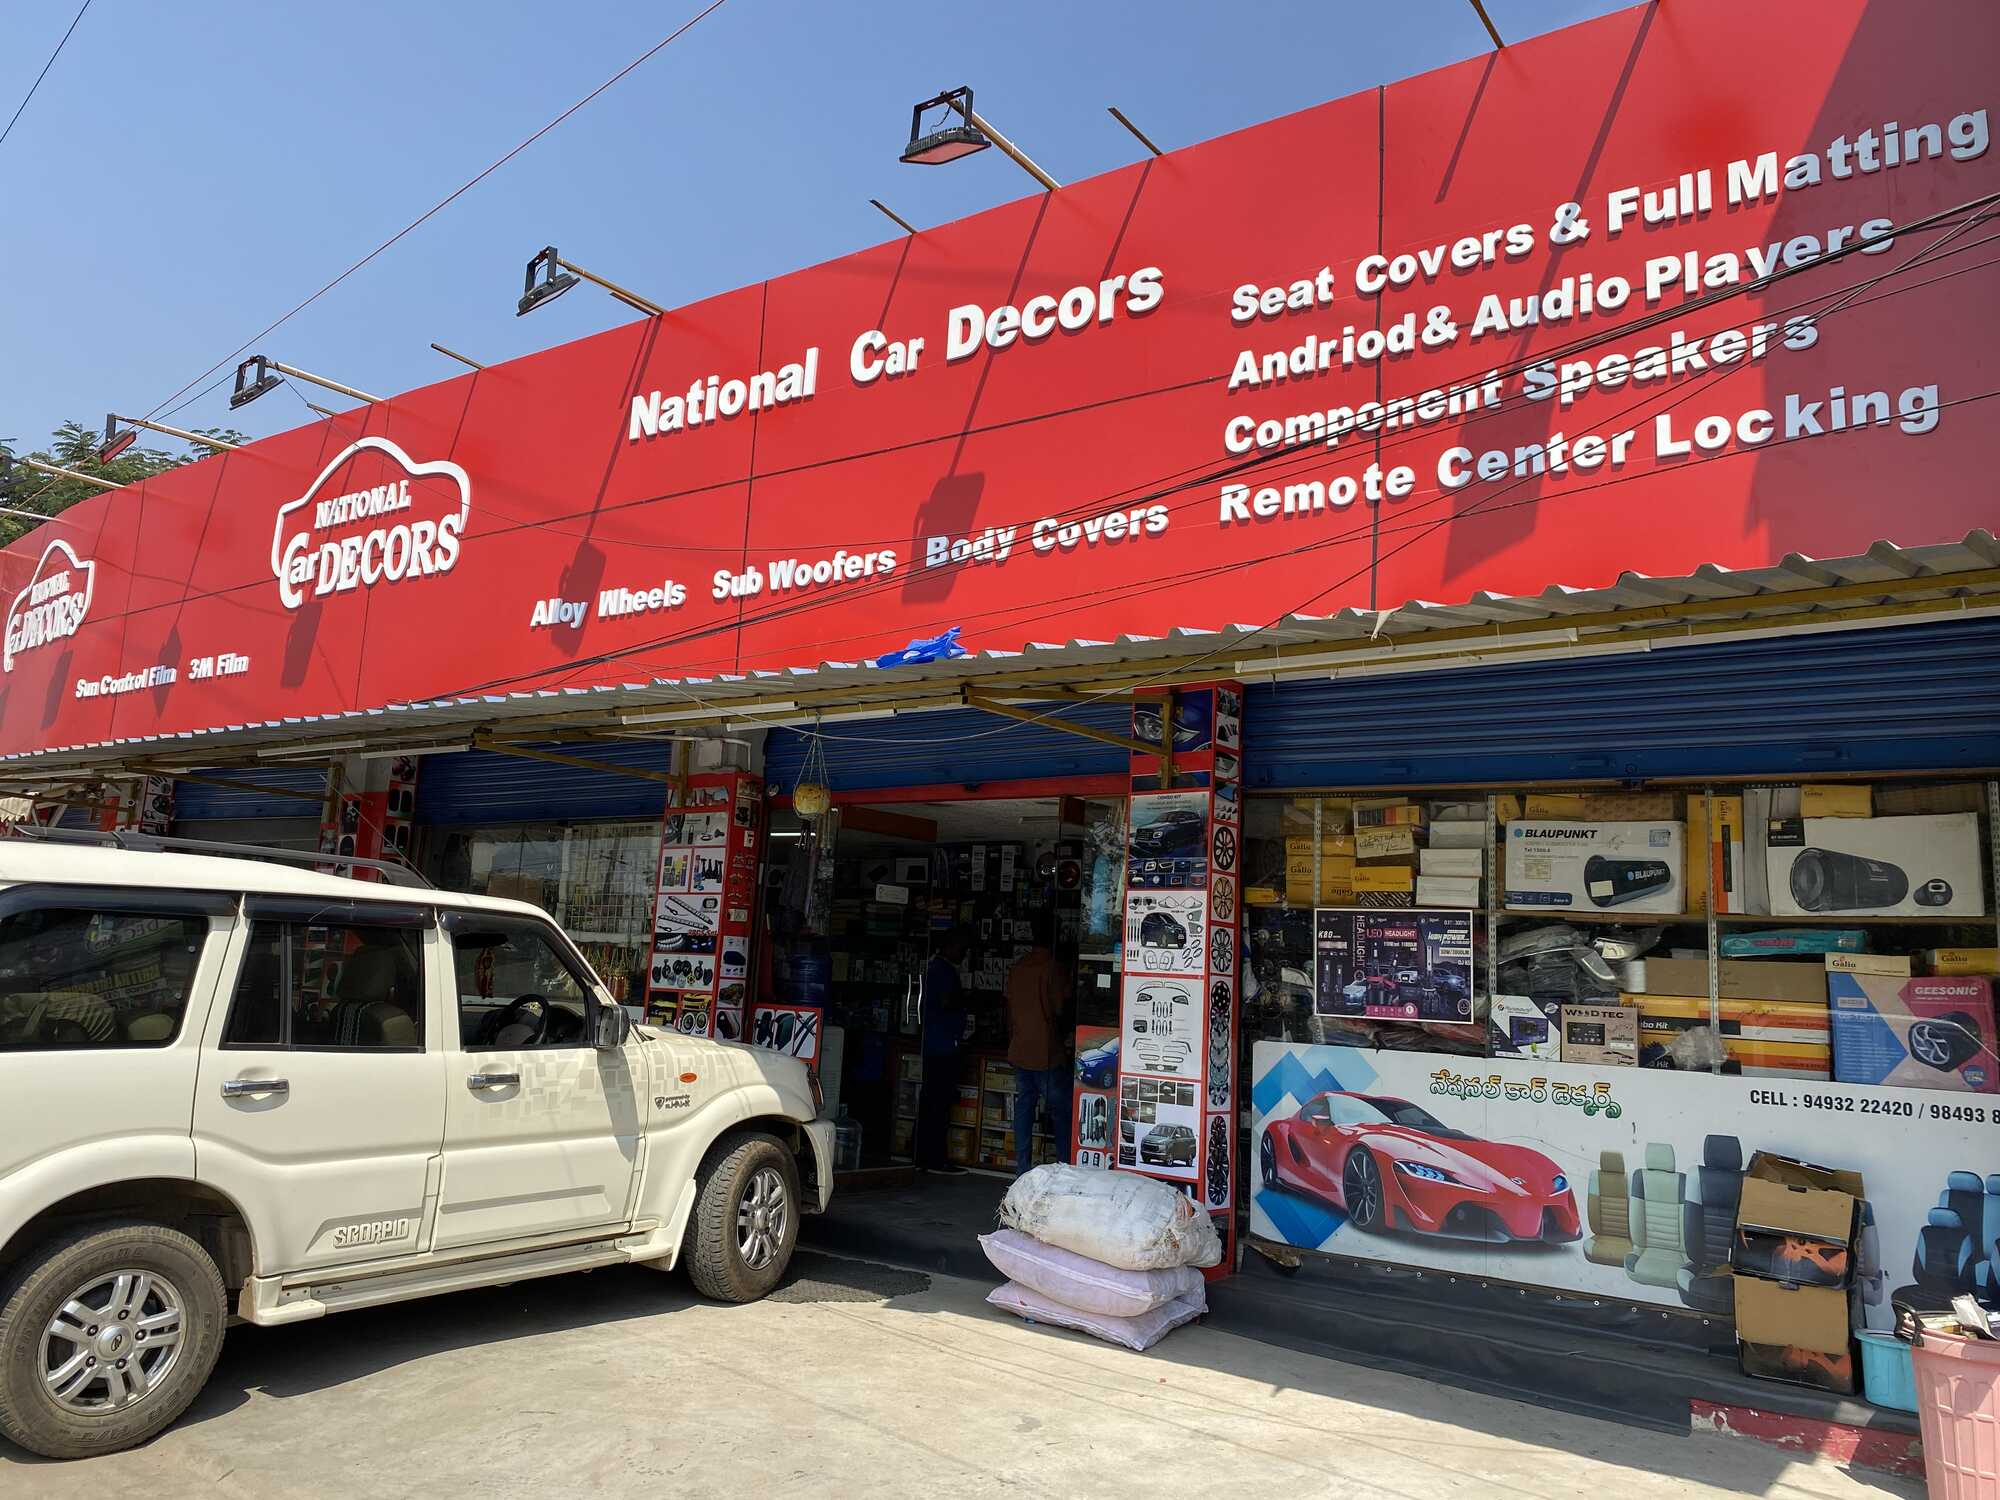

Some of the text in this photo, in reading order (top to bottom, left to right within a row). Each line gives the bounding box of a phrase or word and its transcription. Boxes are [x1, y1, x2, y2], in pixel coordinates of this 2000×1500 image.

[1231, 108, 1990, 322] Seat Covers & Full Matting
[1471, 272, 1631, 338] Audio
[1645, 214, 1896, 301] Players
[629, 266, 1165, 441] National Car Decors
[1224, 310, 1819, 455] Component Speakers
[1220, 383, 1941, 523] Remote Center Locking
[314, 479, 412, 530] NATIONAL
[315, 513, 463, 597] DECORS
[530, 504, 1169, 630] Alloy Wheels Sub Woofers Body Covers
[76, 665, 177, 698] Sun Control Film
[189, 653, 249, 681] 3M Film
[1525, 829, 1598, 839] BLAUPUNKT
[1635, 868, 1666, 880] BLAUPUNKT
[1357, 915, 1366, 967] HEADLIGHT
[1367, 928, 1382, 937] LED
[1914, 986, 1979, 996] GEESONIC
[1430, 1068, 1502, 1101] నేషనల్
[1504, 1077, 1548, 1103] కార్
[1750, 1089, 1788, 1106] CELL
[1803, 1094, 1855, 1112] 94932
[1860, 1098, 1913, 1117] 22420
[1918, 1103, 1925, 1119] /
[1930, 1104, 1986, 1123] 98493
[334, 1217, 409, 1248] SCORPIO
